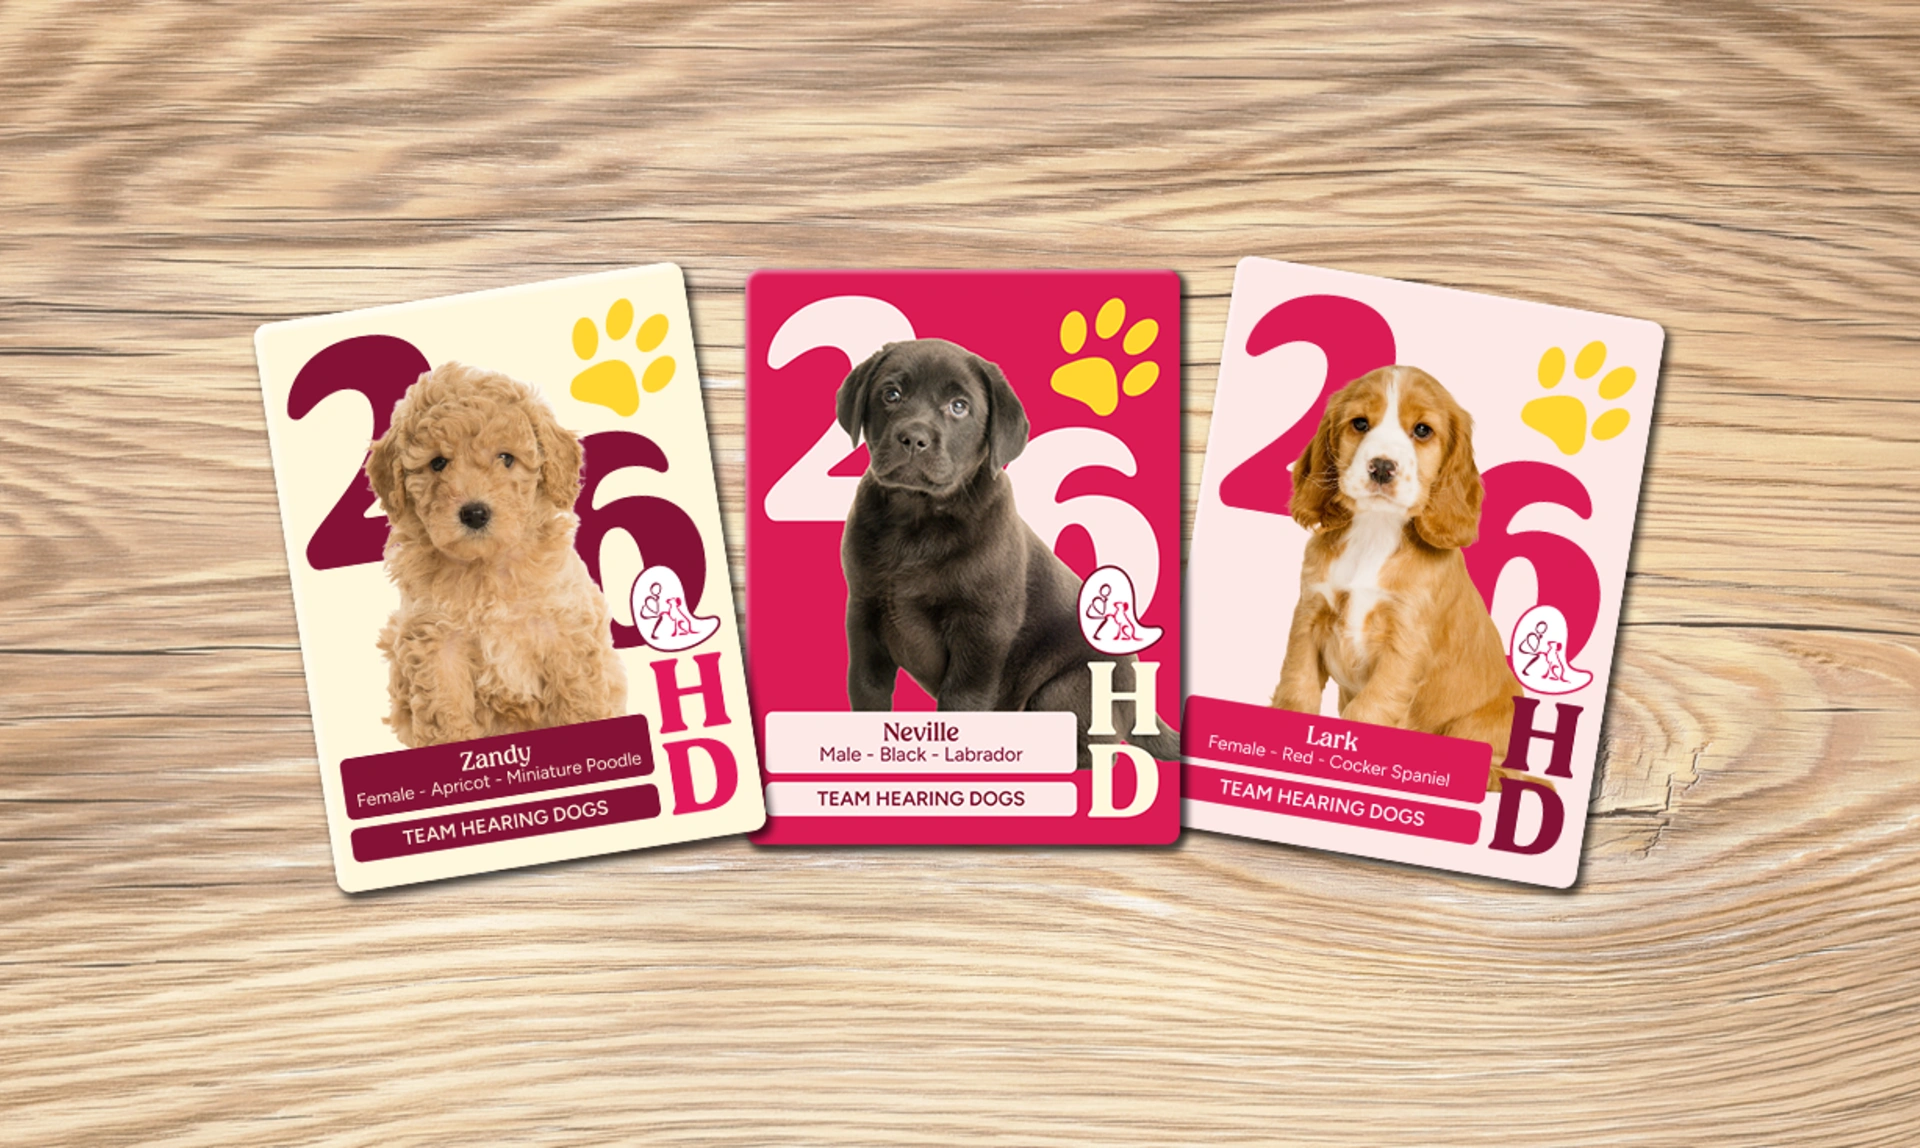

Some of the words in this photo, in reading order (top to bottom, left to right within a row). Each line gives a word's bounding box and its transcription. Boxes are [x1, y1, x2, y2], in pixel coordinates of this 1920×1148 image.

[883, 721, 959, 742] Neville
[1306, 725, 1359, 751] Lark
[460, 744, 532, 771] Zandy
[820, 746, 862, 762] Male
[880, 746, 927, 762] Black
[945, 746, 1023, 762] Labrador
[1208, 734, 1266, 757] Female
[1282, 747, 1314, 765] Red
[1329, 755, 1388, 777] Cocker
[1391, 764, 1450, 787] Spaniel
[356, 787, 415, 808] Female
[431, 775, 491, 798] Apricot
[507, 763, 582, 785] Miniature
[586, 752, 642, 772] Poodle
[817, 791, 870, 806] TEAM
[876, 791, 965, 807] HEARING
[970, 791, 1025, 807] DOGS
[1220, 778, 1273, 802] TEAM
[1277, 788, 1365, 817] HEARING
[1369, 804, 1425, 827] DOGS
[402, 823, 457, 845] TEAM
[461, 809, 549, 837] HEARING
[553, 800, 609, 822] DOGS
